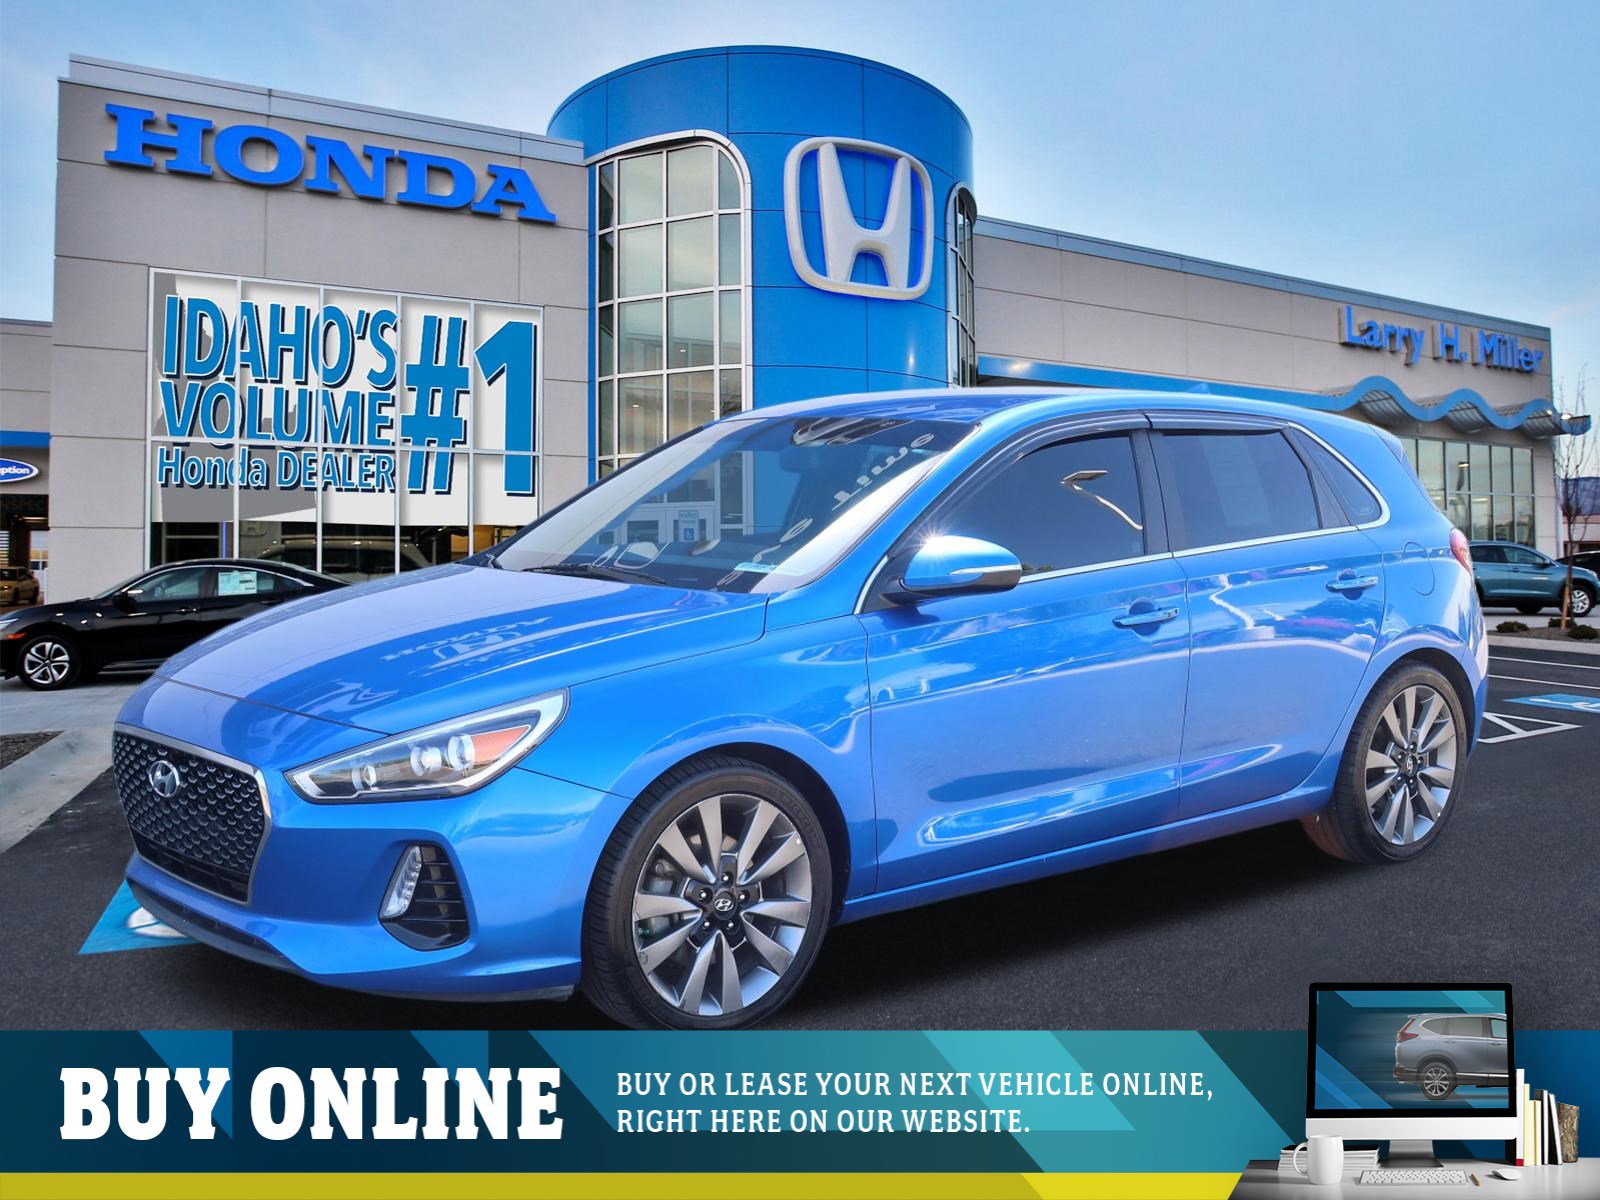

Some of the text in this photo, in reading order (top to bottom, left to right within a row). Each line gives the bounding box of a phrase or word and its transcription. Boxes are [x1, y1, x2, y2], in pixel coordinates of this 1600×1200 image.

[104, 103, 557, 224] HONDA
[163, 294, 398, 390] IDAHO'S
[1340, 305, 1543, 372] Larry H. Miller
[159, 380, 397, 450] VOLUME
[400, 315, 537, 497] #1
[0, 465, 30, 476] ption
[156, 446, 396, 493] Honda DEALER
